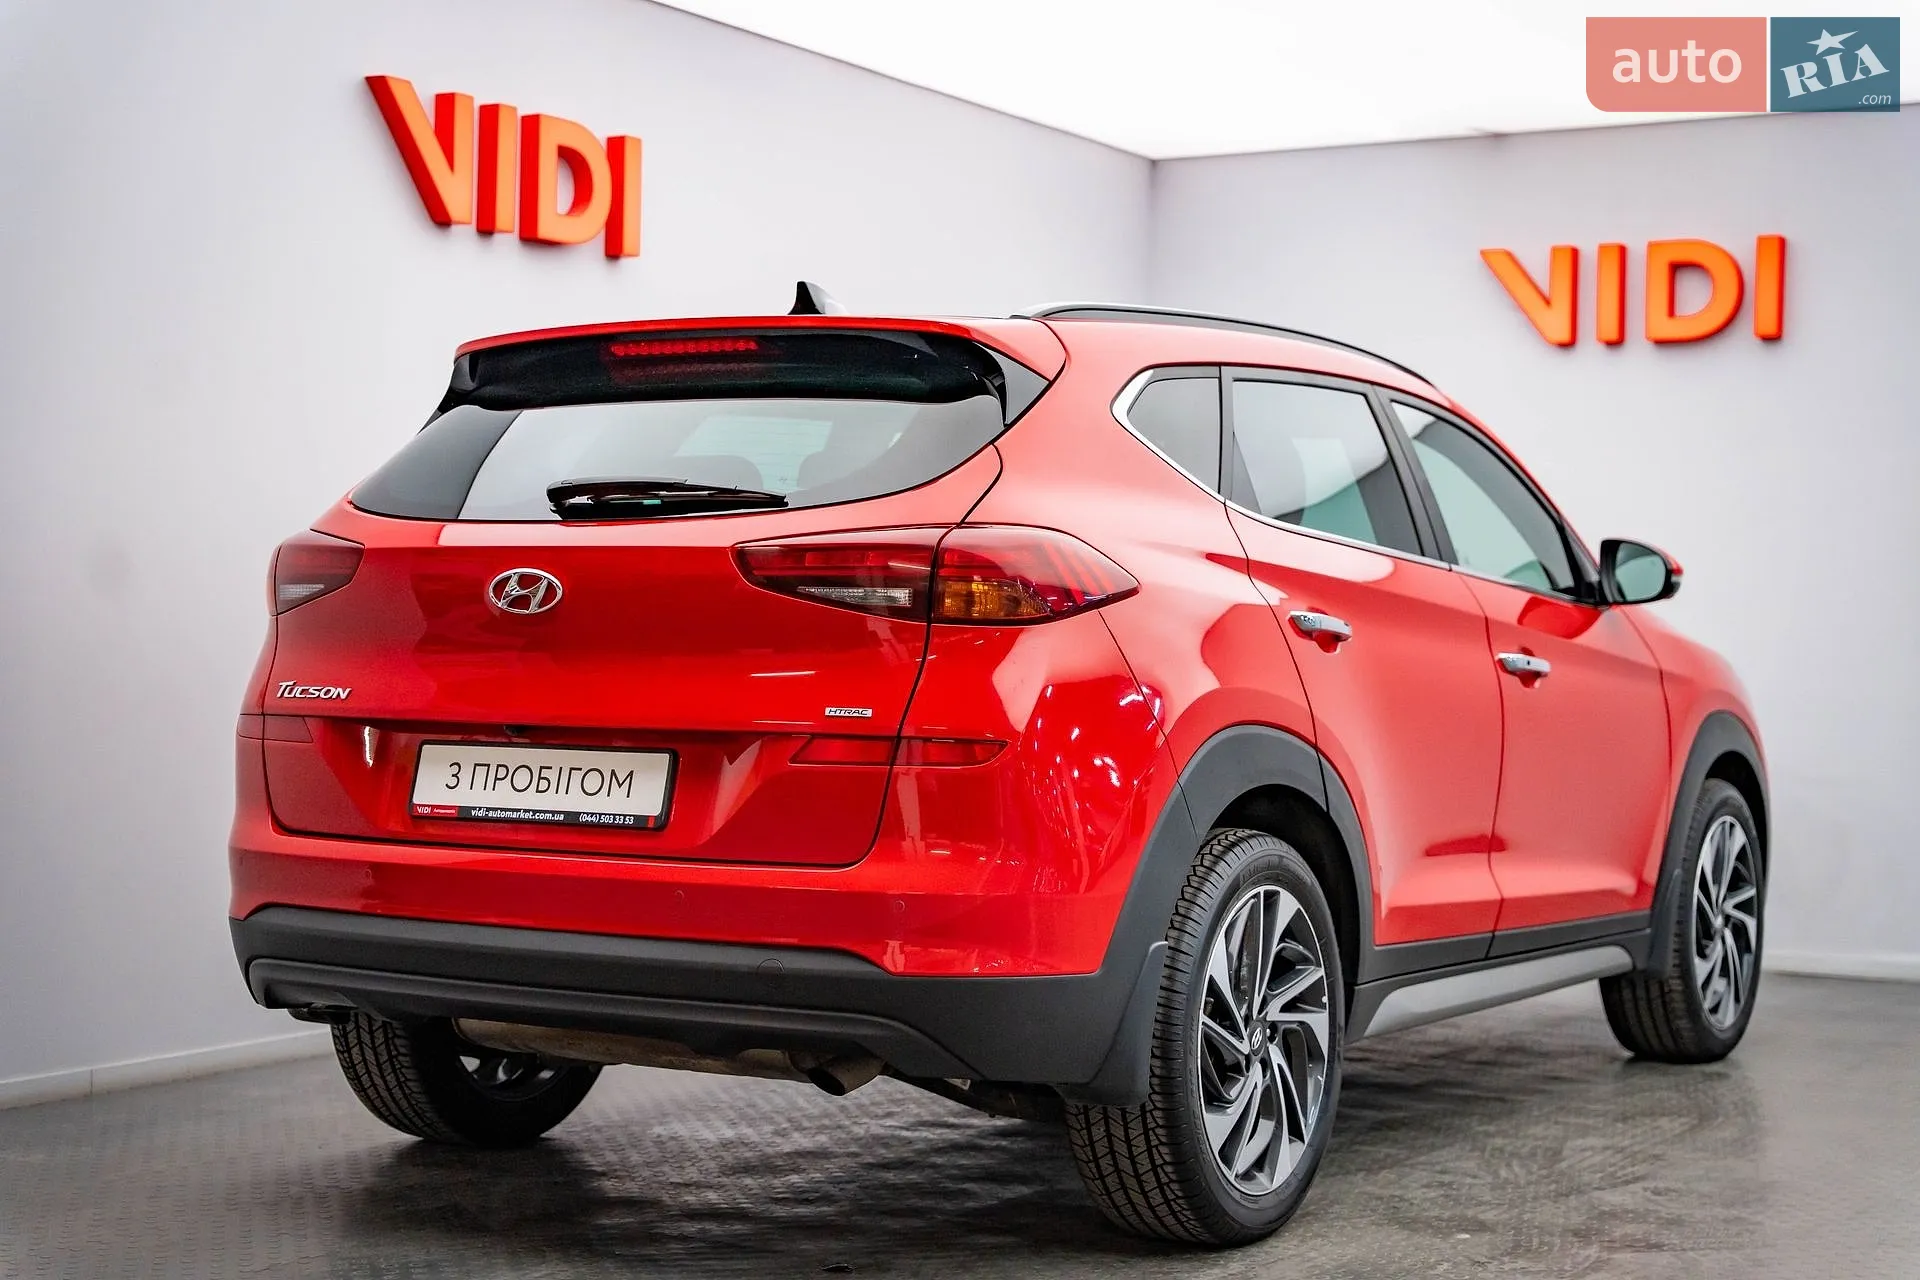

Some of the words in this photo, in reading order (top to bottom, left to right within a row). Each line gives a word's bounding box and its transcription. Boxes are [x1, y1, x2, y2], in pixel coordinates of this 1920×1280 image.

[364, 75, 642, 259] VIDI
[1479, 234, 1787, 347] VIDI
[828, 708, 869, 716] HTRAC
[469, 763, 634, 798] ПРОБІГОМ
[416, 806, 432, 814] VIDI
[471, 808, 564, 820] vidi-automarket.com.ua
[579, 813, 599, 823] (044)
[600, 815, 613, 824] 503
[614, 815, 624, 824] 33
[624, 816, 634, 824] 53
